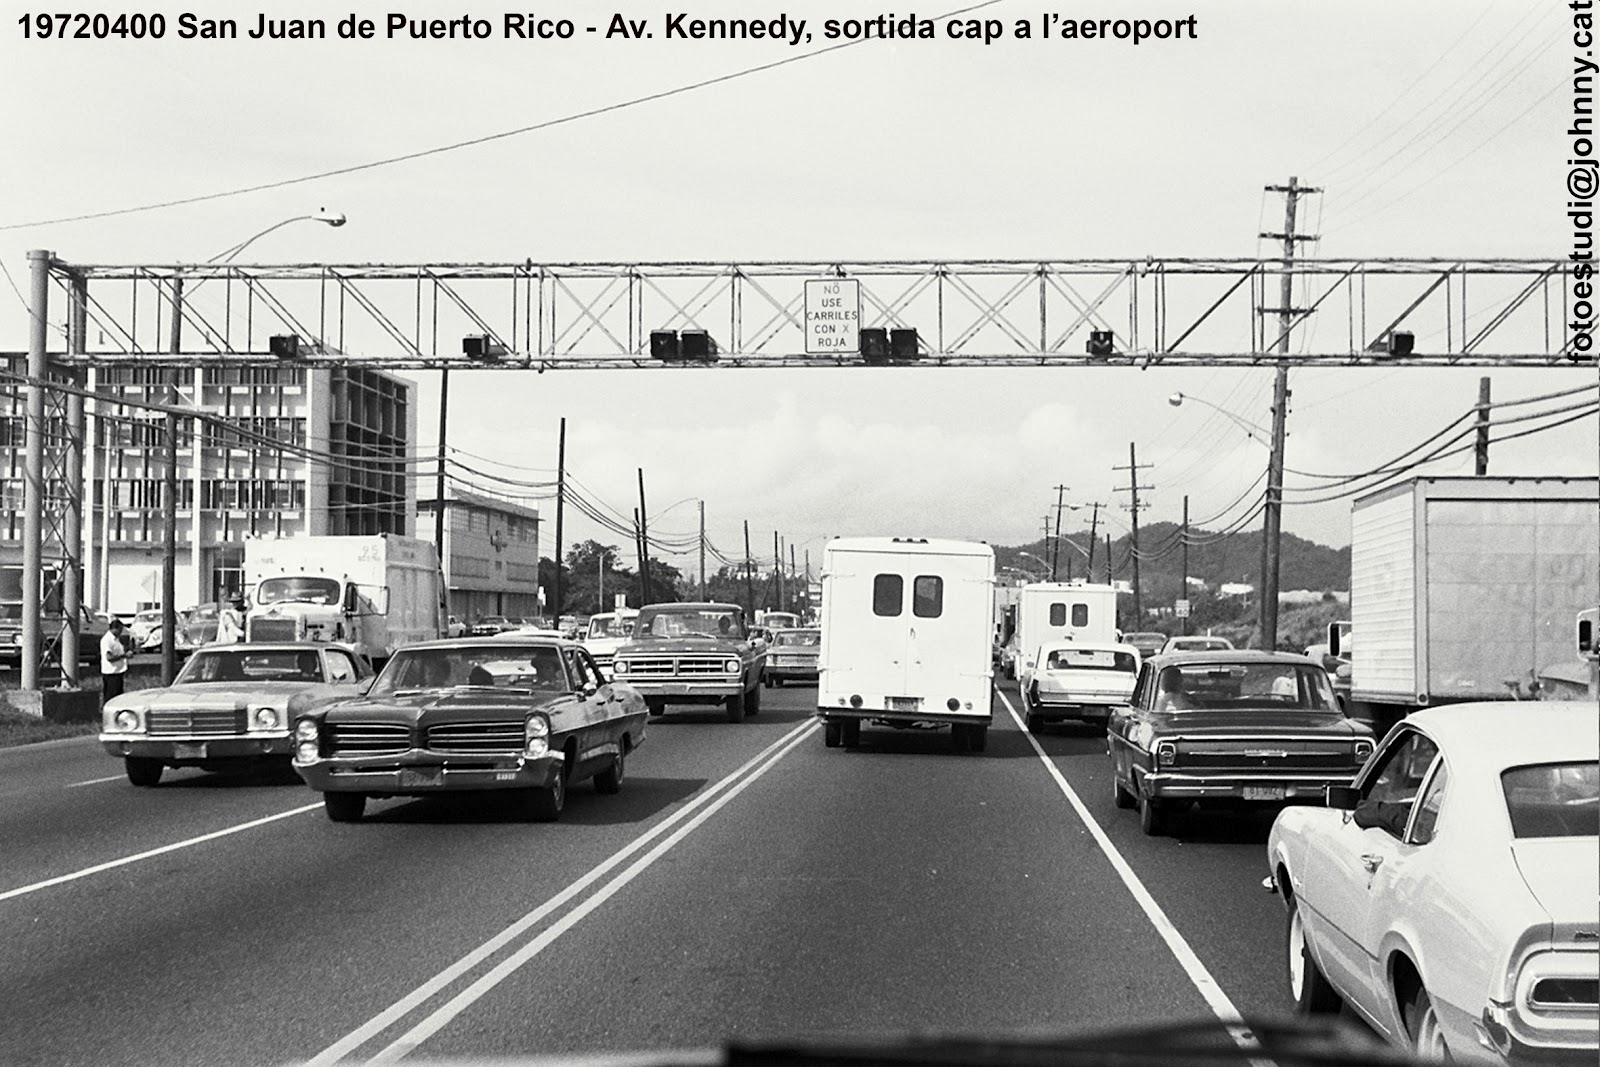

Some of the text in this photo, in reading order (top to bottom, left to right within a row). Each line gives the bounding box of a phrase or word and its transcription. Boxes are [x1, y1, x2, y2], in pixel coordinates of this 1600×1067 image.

[824, 285, 840, 294] NO
[821, 298, 842, 307] USE
[807, 311, 858, 320] CARRILES
[814, 324, 849, 333] CON X
[818, 338, 846, 346] ROJA
